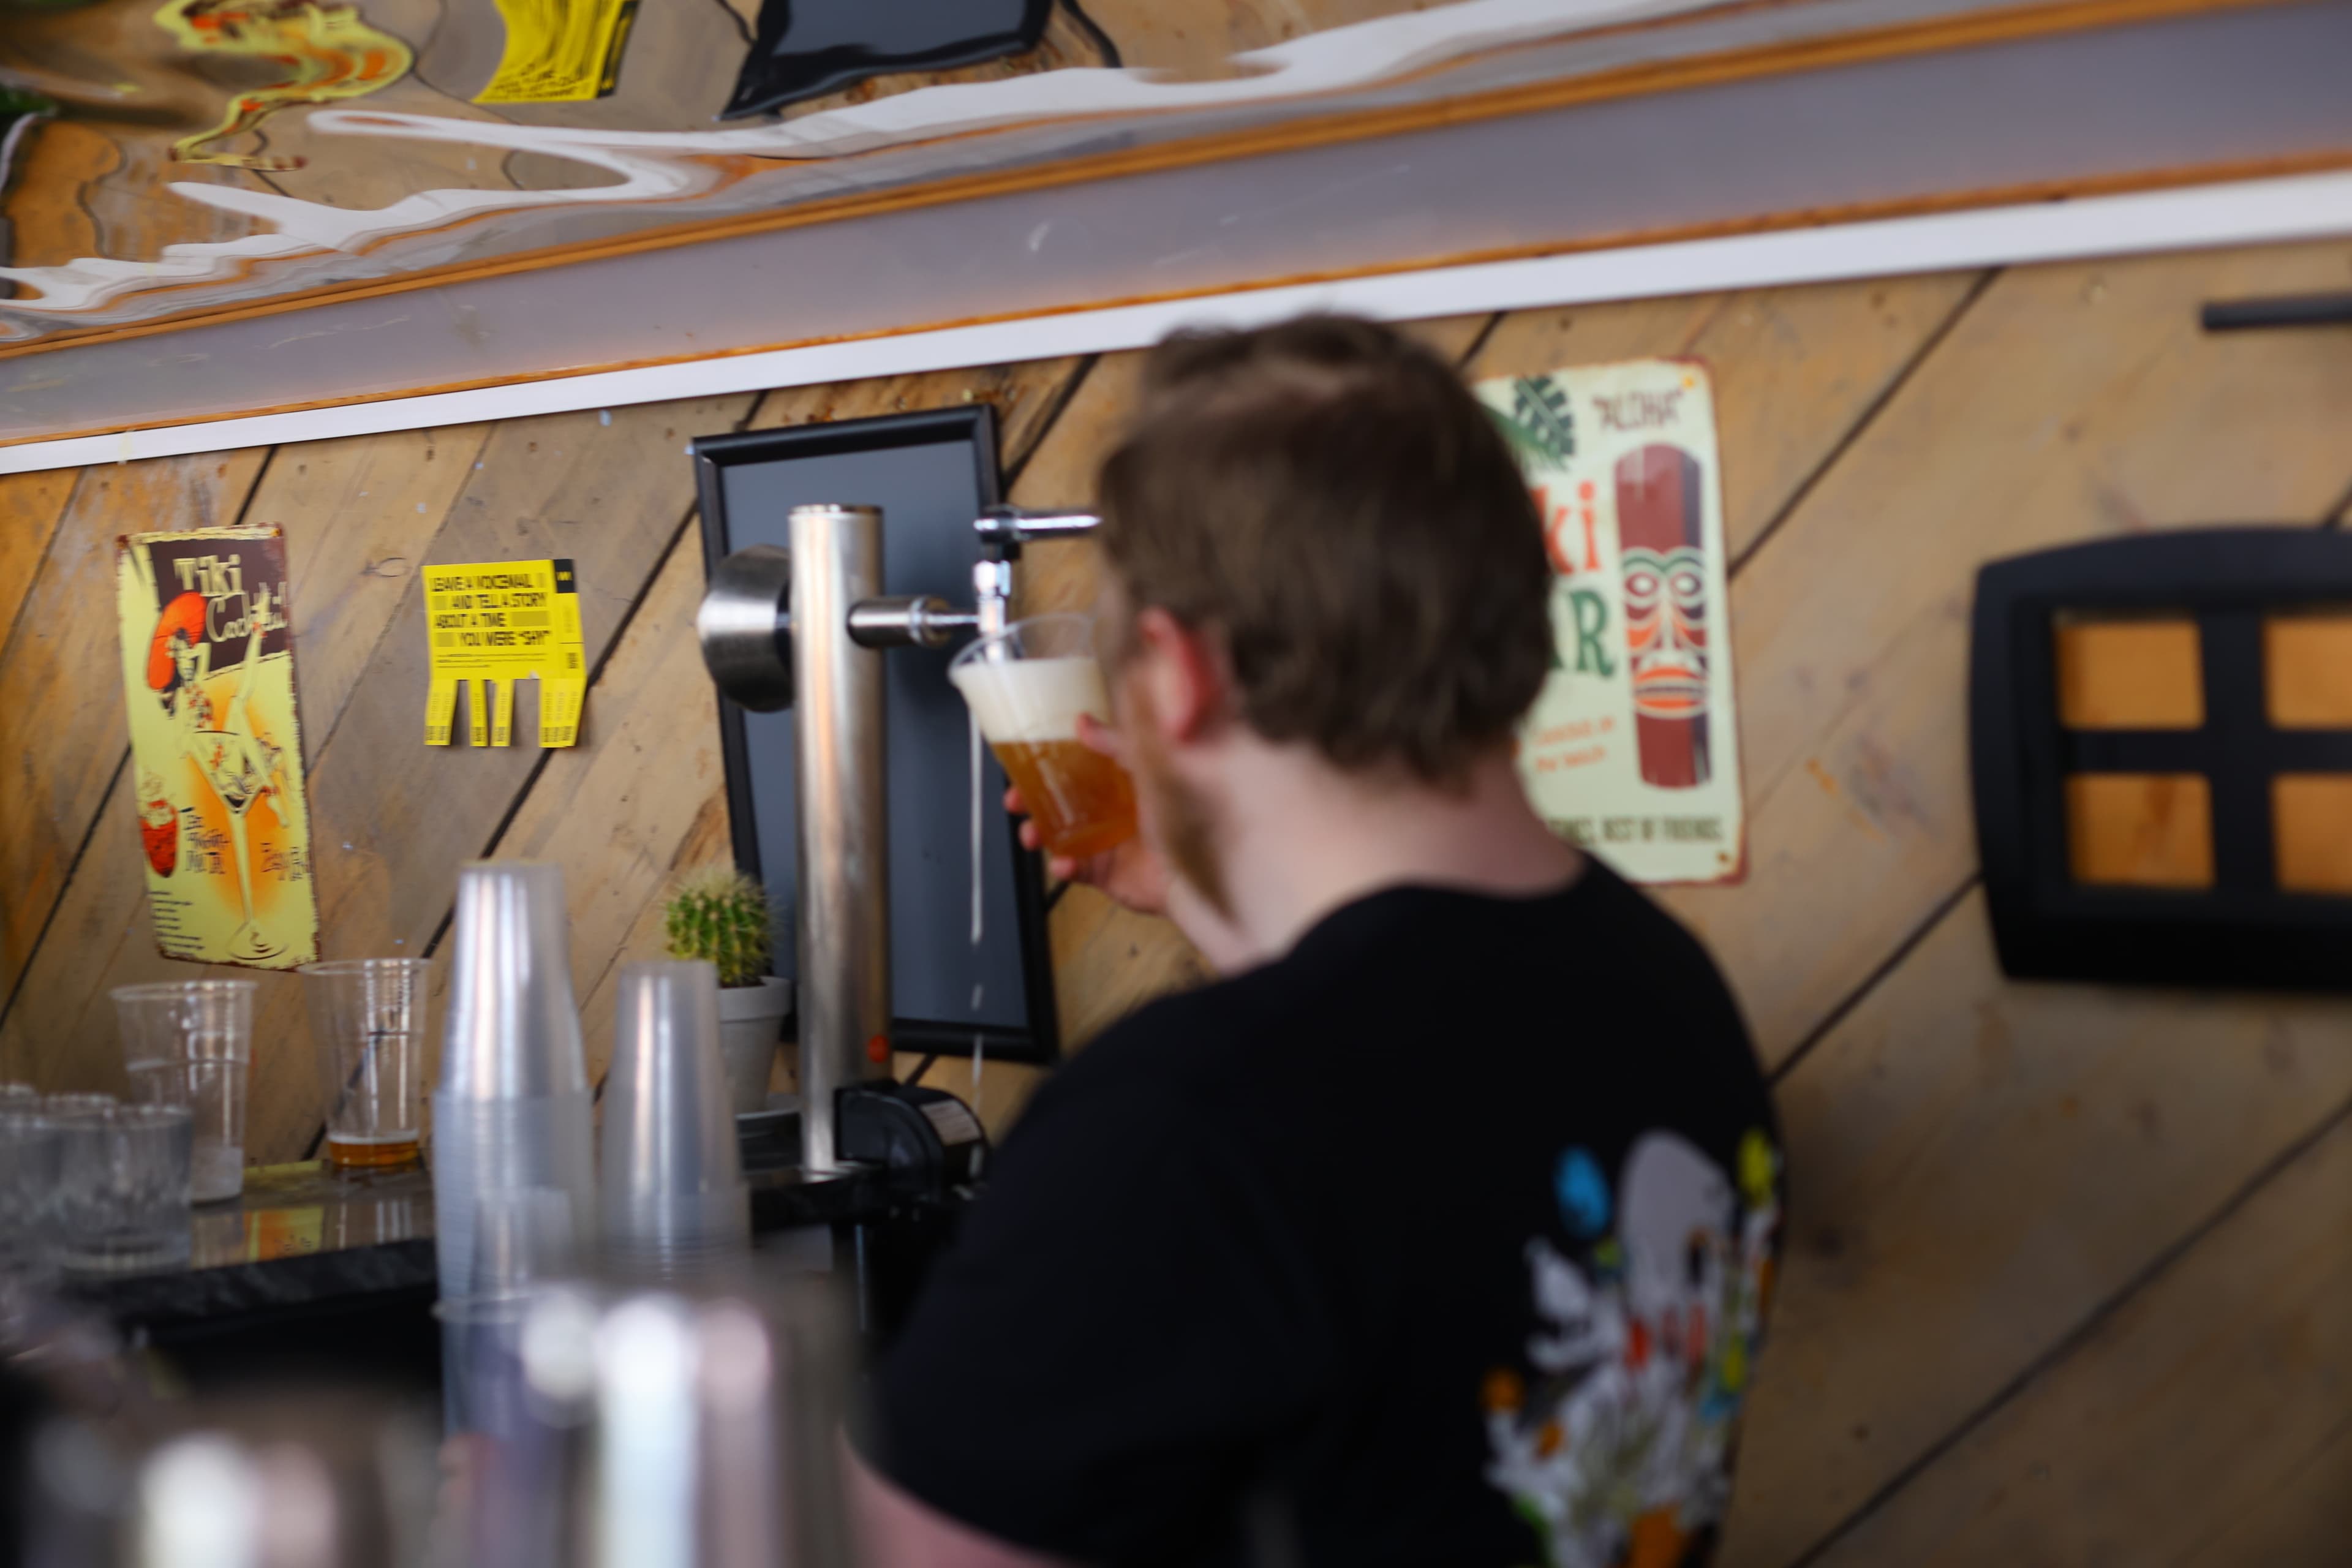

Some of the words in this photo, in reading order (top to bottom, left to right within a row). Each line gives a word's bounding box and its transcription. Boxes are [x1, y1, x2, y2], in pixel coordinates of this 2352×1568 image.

[172, 554, 246, 597] Tiki
[431, 576, 464, 592] LEAVE
[466, 576, 473, 589] A
[476, 574, 533, 589] VOICEMAIL
[451, 595, 472, 609] AND
[475, 594, 500, 609] TELL
[511, 592, 548, 608] STORY
[435, 613, 467, 628] ABOUT
[470, 613, 478, 627] A
[480, 612, 507, 627] TIME
[460, 631, 481, 646] YOU
[483, 631, 516, 646] WERE
